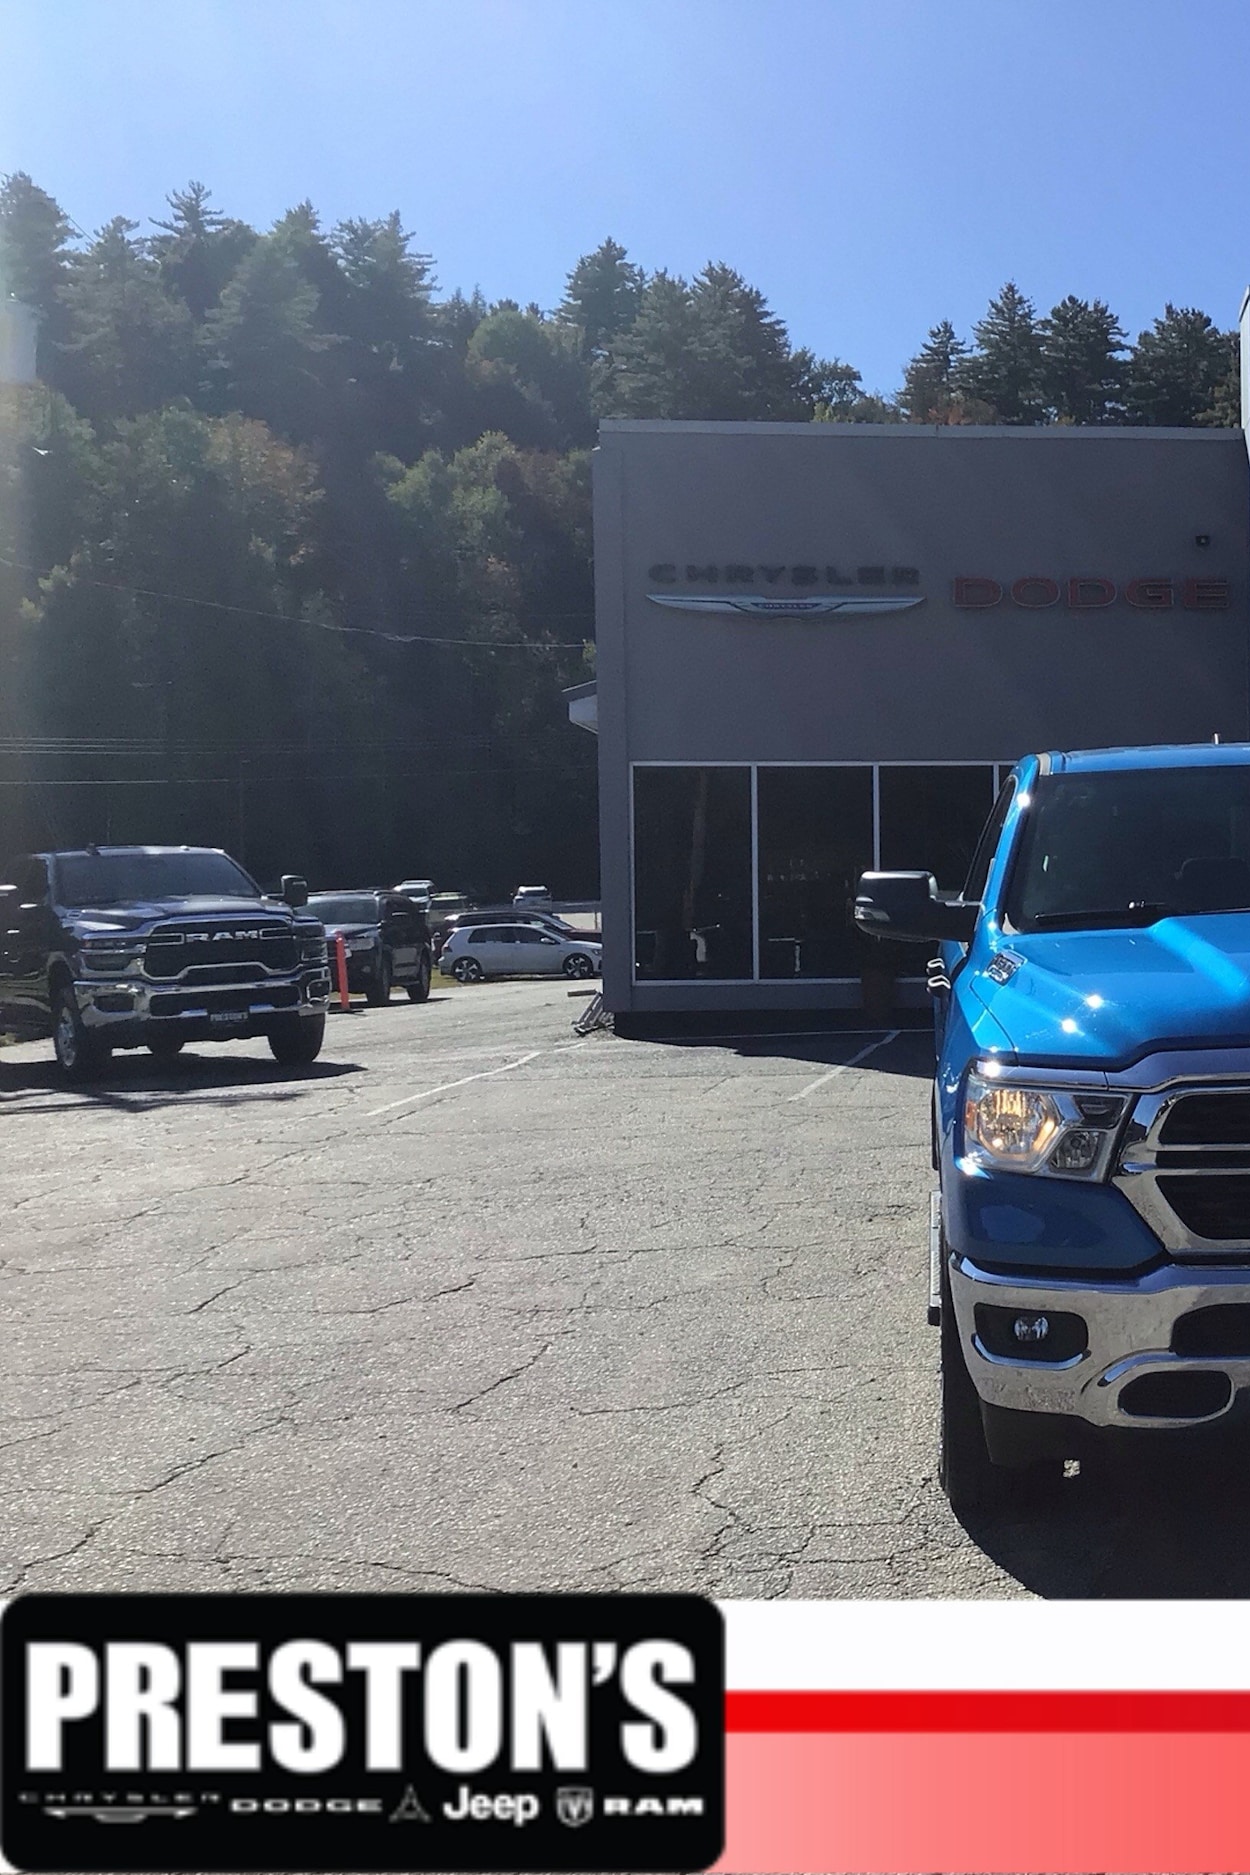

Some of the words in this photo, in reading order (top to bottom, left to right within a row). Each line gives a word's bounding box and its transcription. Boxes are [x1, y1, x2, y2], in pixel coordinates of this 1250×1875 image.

[647, 563, 921, 586] CHRYSLER
[952, 576, 1232, 609] DODGE
[186, 930, 259, 943] RAM
